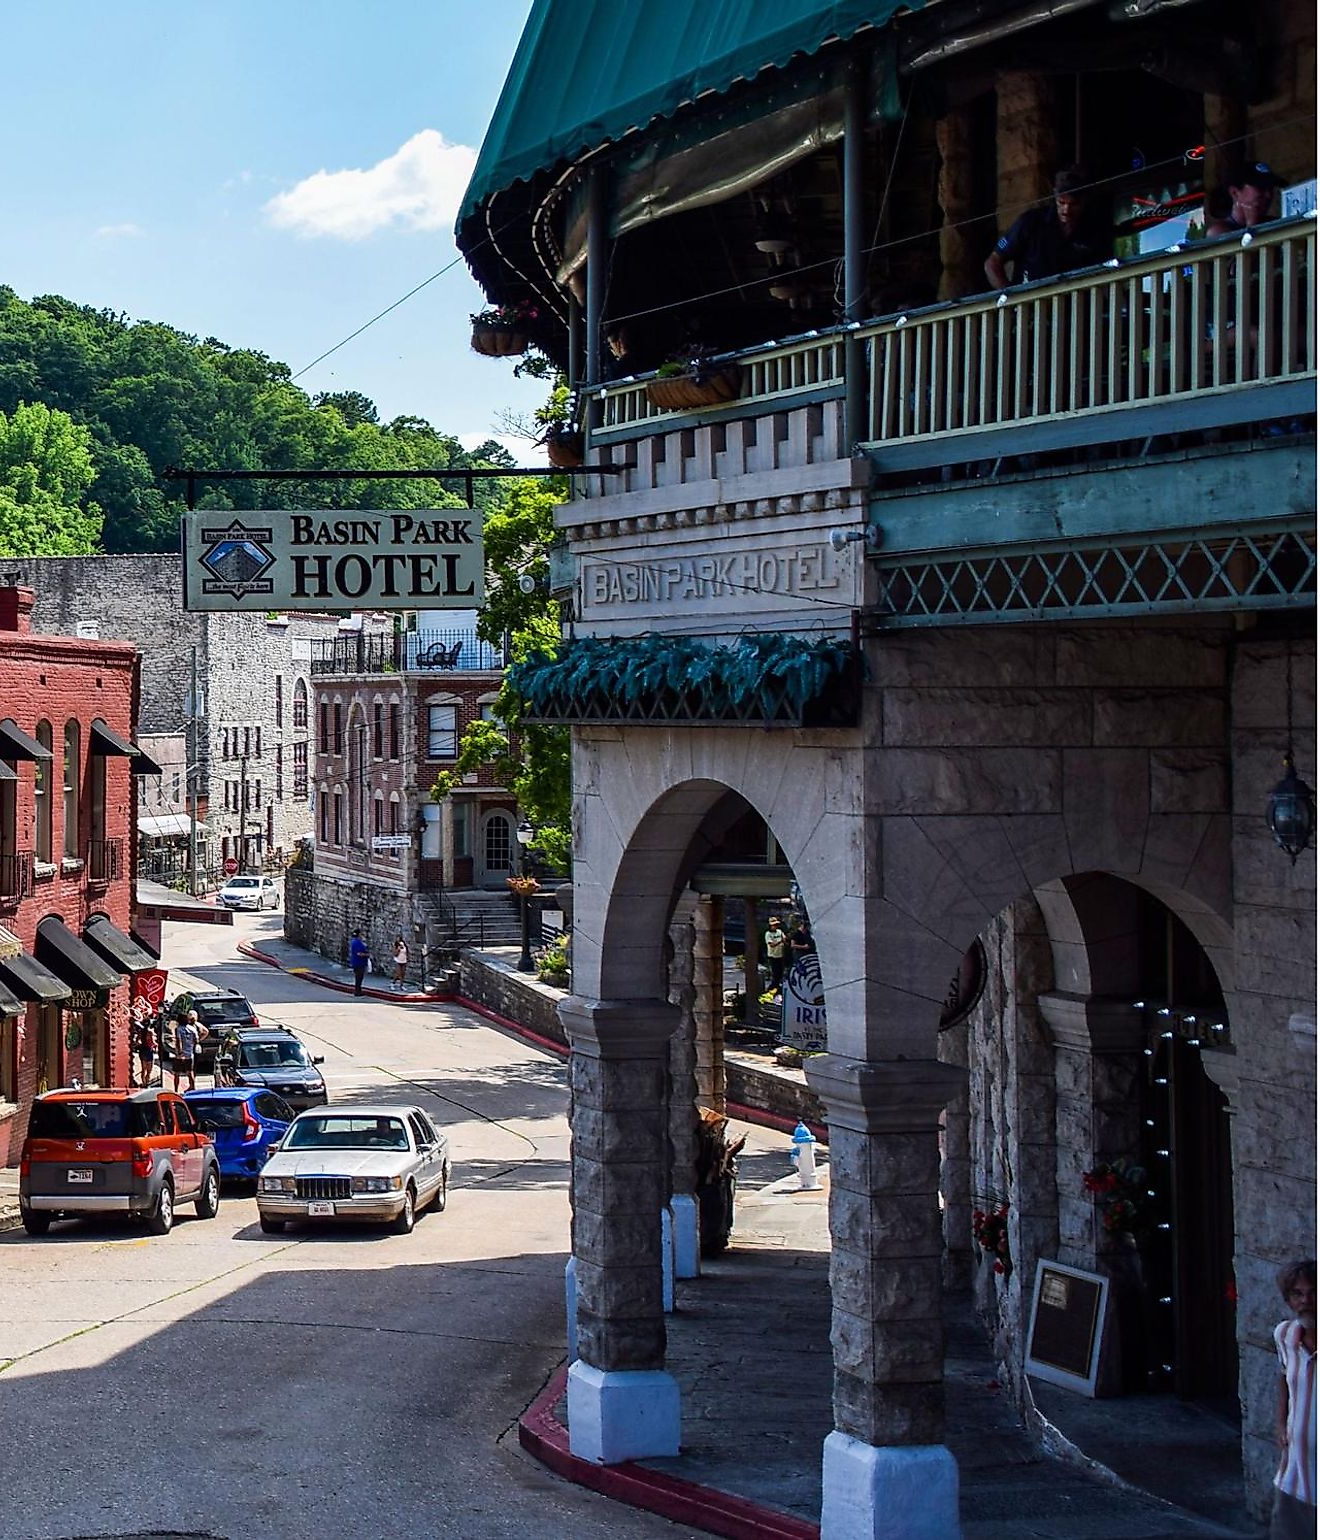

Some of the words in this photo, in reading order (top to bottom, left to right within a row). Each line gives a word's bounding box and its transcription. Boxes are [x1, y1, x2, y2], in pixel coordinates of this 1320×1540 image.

[290, 515, 380, 545] BASIN
[391, 514, 473, 544] PARK
[290, 554, 475, 598] HOTEL
[594, 564, 660, 604] BASIN
[665, 556, 738, 601] PARK
[739, 548, 840, 596] HOTEL
[64, 999, 96, 1008] SHOP
